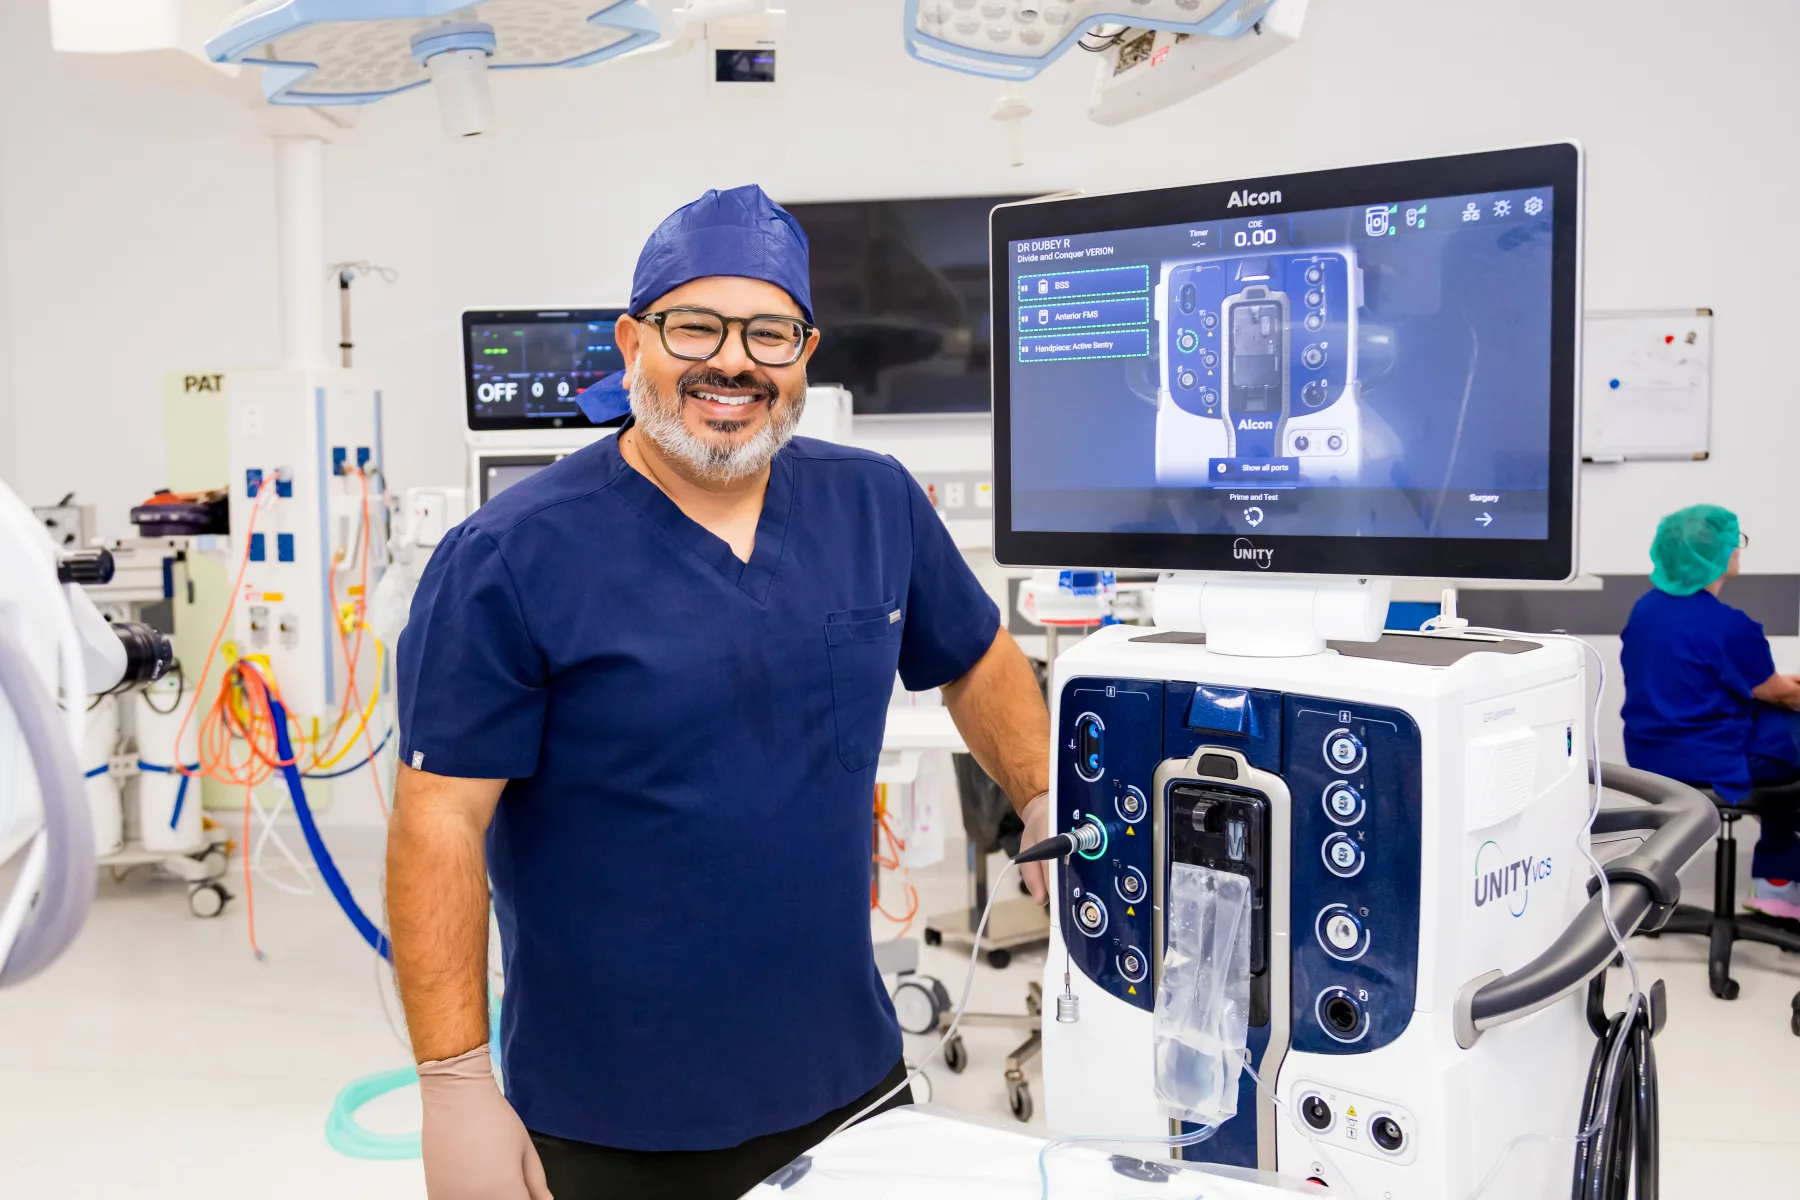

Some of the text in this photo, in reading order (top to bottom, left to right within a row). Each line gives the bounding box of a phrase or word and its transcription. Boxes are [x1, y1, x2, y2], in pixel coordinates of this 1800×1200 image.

[1226, 189, 1282, 208] Alcon
[1247, 220, 1263, 228] CDE
[1189, 229, 1208, 238] Timer
[1234, 228, 1277, 247] 0.00
[1017, 238, 1071, 253] DR DUBEY R
[1017, 246, 1114, 263] Divide and Conquer VERION
[1054, 281, 1070, 290] BSS
[1054, 310, 1099, 321] Anterior FMS
[1035, 341, 1114, 354] Handpiece: Active Sentry
[184, 374, 226, 392] PAT
[477, 382, 518, 402] OFF
[1237, 418, 1273, 430] Alcon
[1241, 464, 1289, 473] Show all ports
[1229, 493, 1279, 501] Prime and Test
[1468, 493, 1500, 503] Surgery
[1233, 548, 1274, 560] UNITY
[1474, 855, 1552, 907] UNITY VCS
